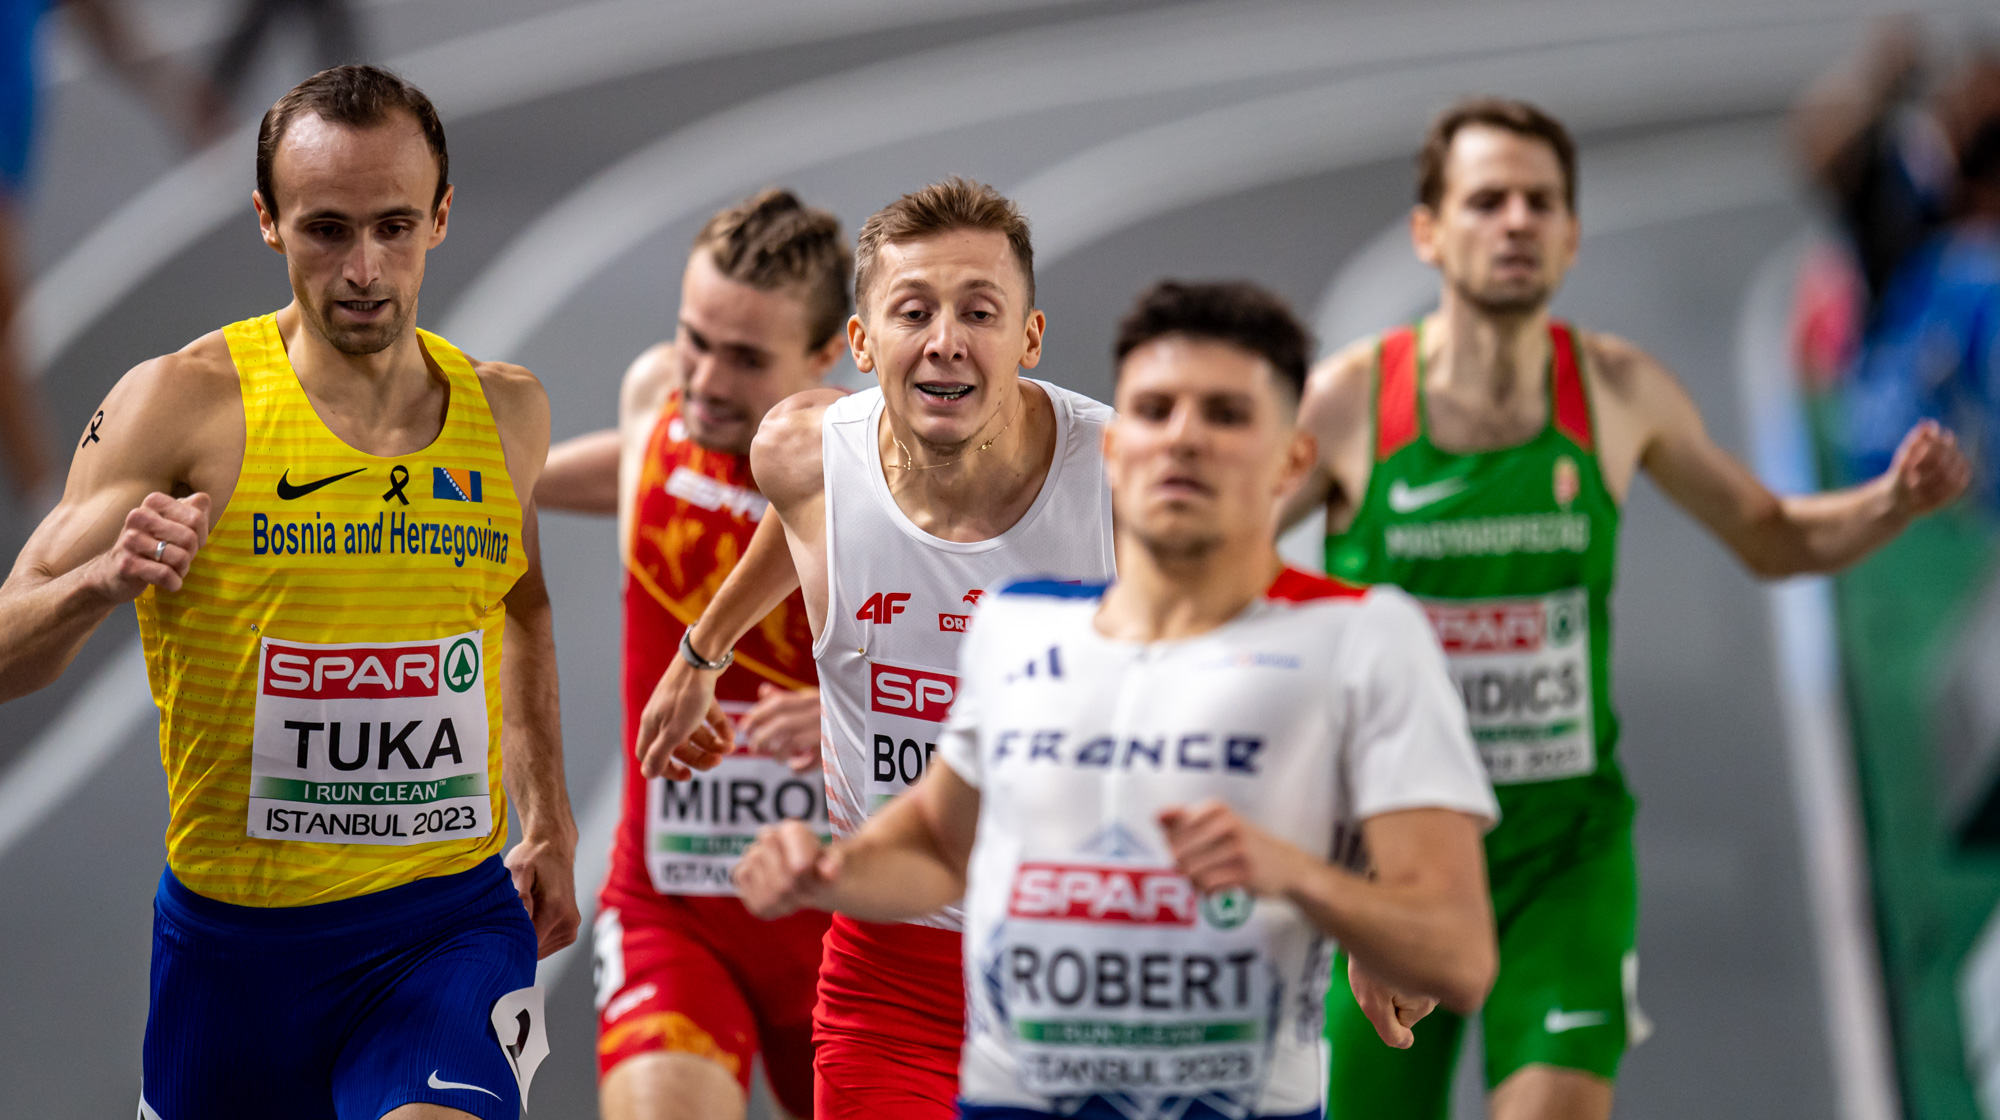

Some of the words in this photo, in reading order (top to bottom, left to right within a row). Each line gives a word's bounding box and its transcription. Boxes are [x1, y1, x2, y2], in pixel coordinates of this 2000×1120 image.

[253, 512, 336, 556] Bosnia
[344, 512, 384, 555] and
[390, 511, 508, 568] Herzegovina
[856, 592, 912, 624] 4F
[269, 652, 436, 692] SPAR
[284, 717, 463, 771] TUKA
[995, 729, 1264, 774] FRANCE
[304, 783, 310, 800] I
[316, 784, 363, 801] RUN
[266, 808, 407, 837] ISTANBUL
[412, 806, 477, 836] 2023
[1015, 868, 1193, 922] SPAR
[1010, 945, 1257, 1011] ROBERT
